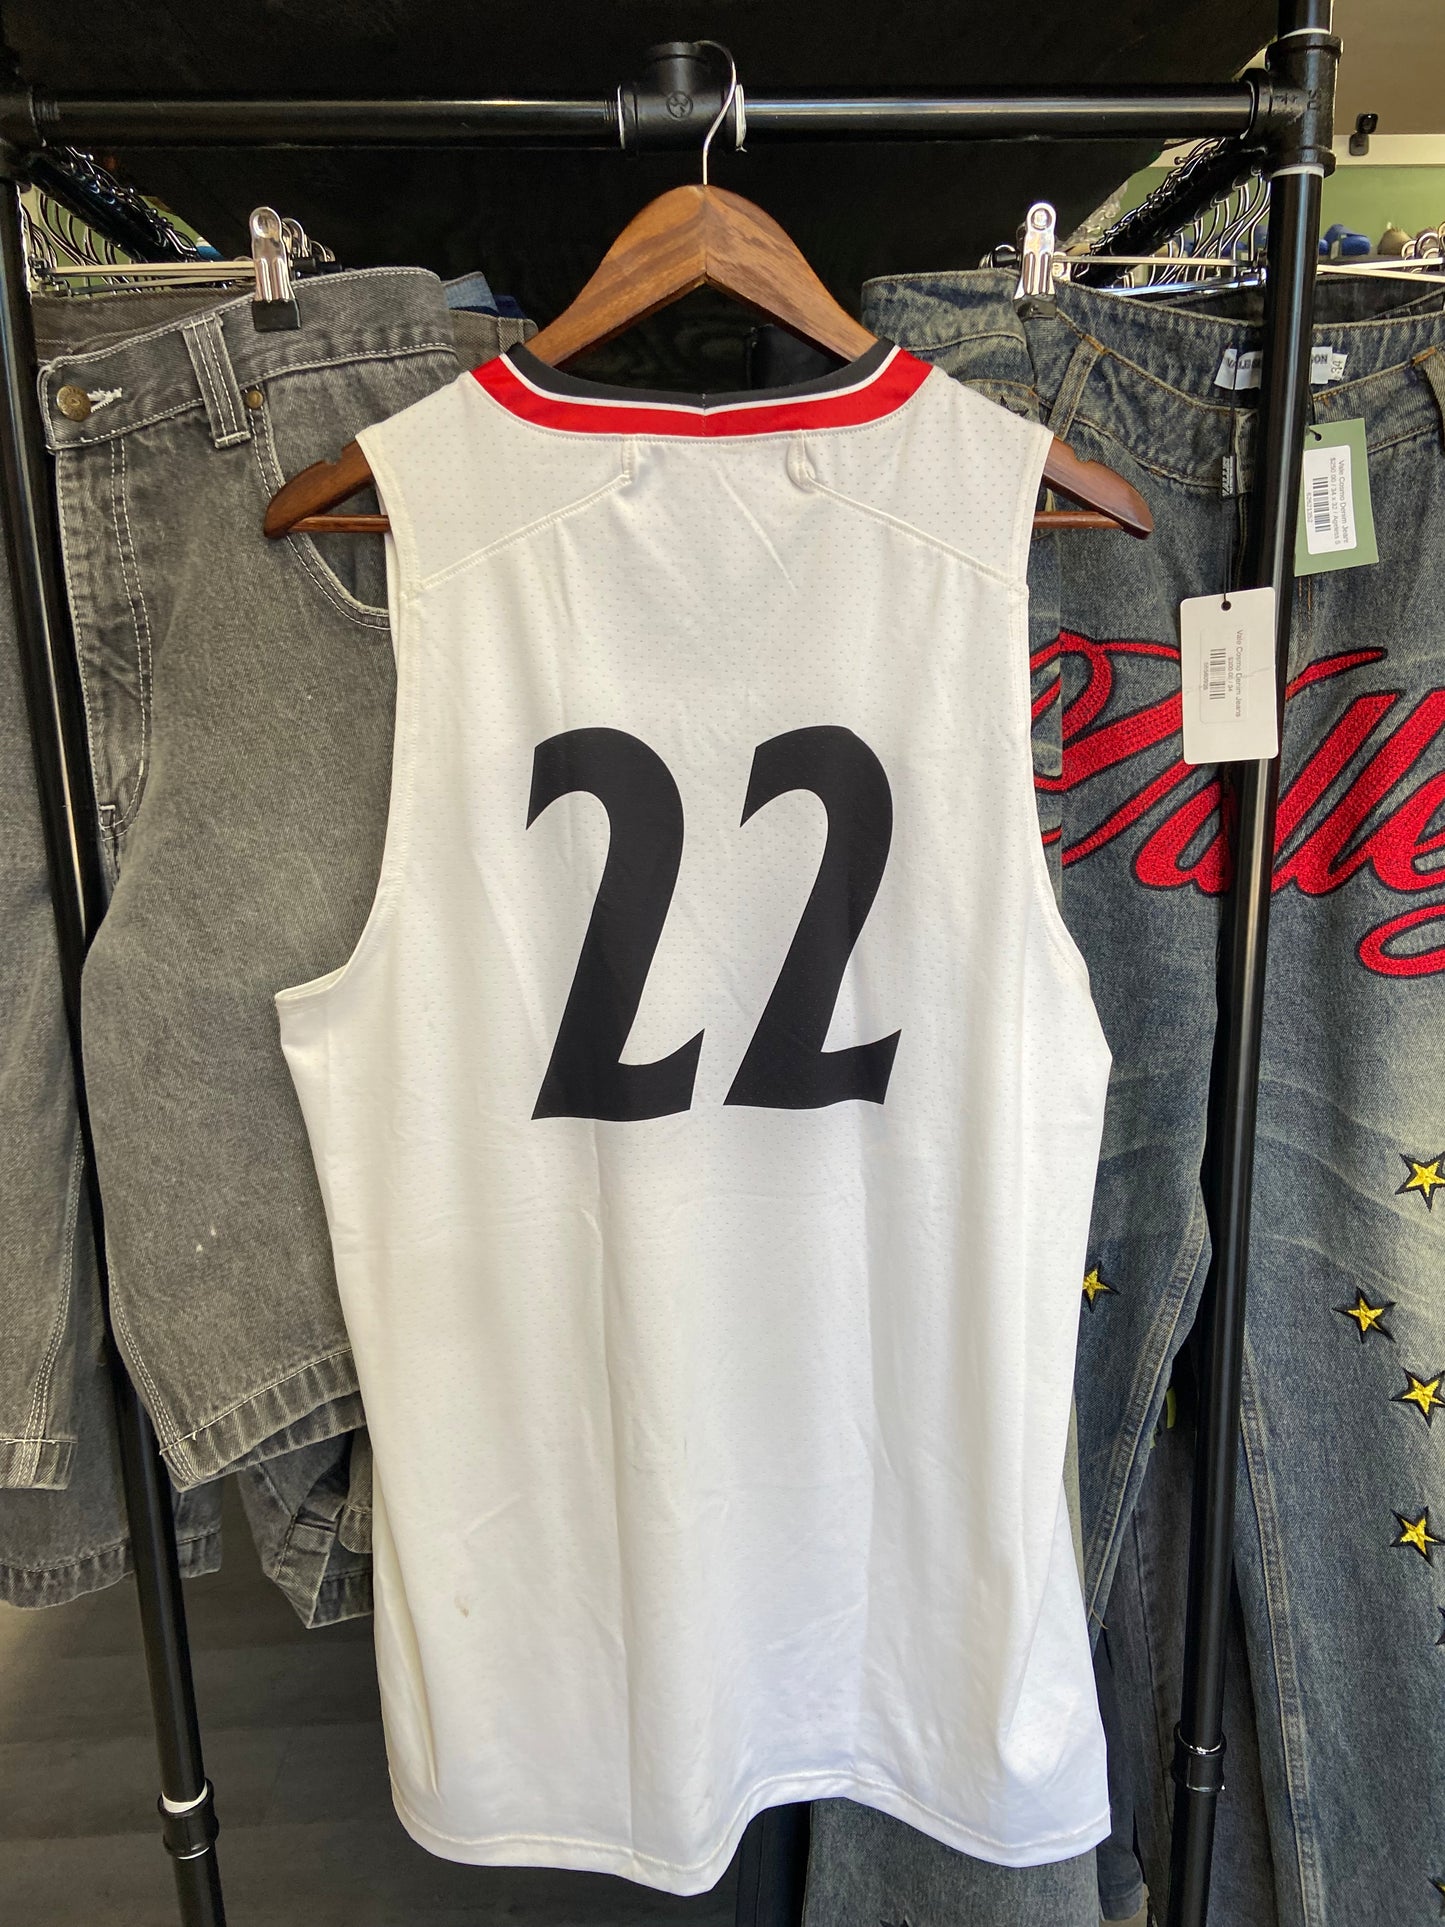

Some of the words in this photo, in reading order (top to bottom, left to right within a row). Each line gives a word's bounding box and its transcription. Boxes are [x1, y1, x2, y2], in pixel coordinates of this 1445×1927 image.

[1338, 460, 1346, 476] Vale
[1331, 487, 1337, 496] 34
[1338, 476, 1346, 501] Cosmo
[1235, 646, 1243, 671] Cosmo
[1235, 672, 1243, 695] Denim
[526, 725, 902, 1122] 22
